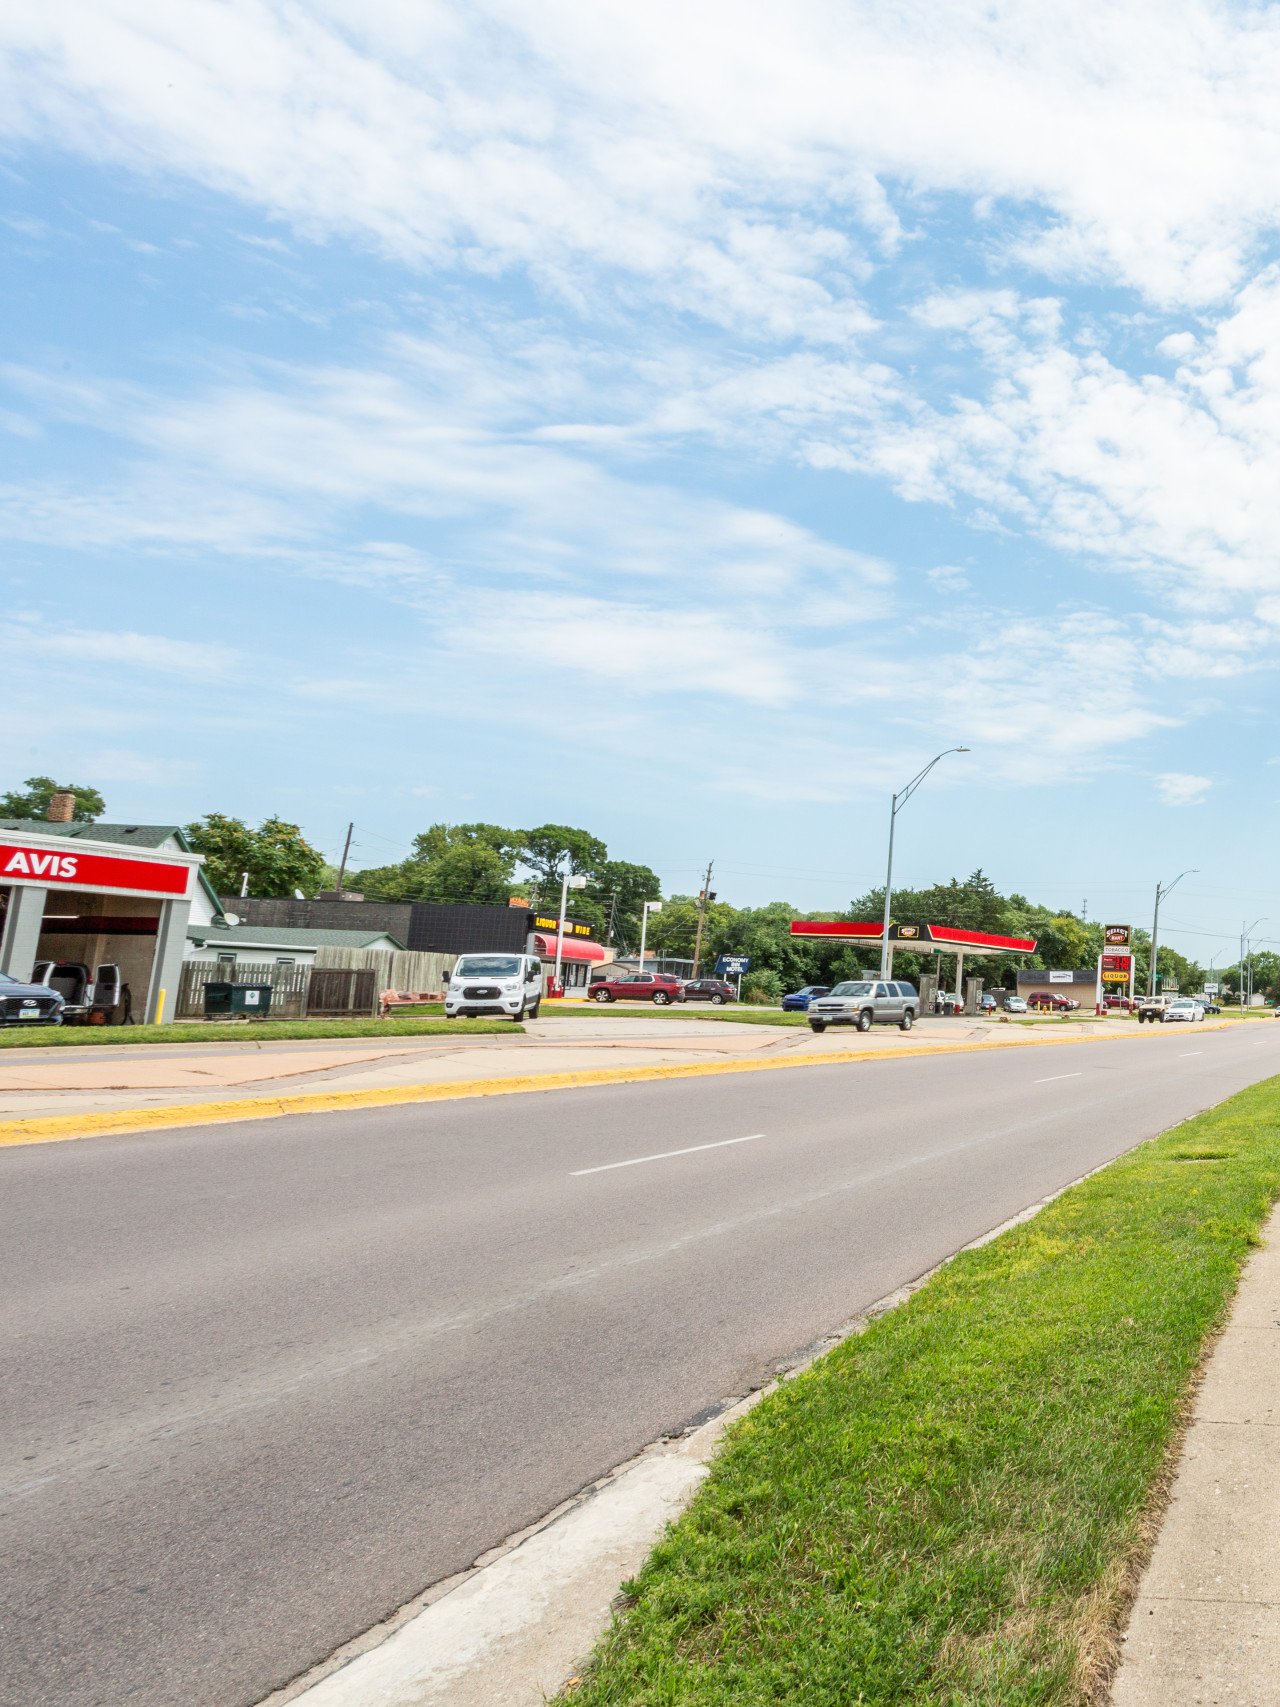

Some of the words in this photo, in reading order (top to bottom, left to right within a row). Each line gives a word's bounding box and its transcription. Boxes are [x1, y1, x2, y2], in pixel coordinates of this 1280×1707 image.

[4, 851, 79, 878] AVIS
[535, 917, 557, 930] LIQUOR
[1106, 928, 1128, 938] SELECT
